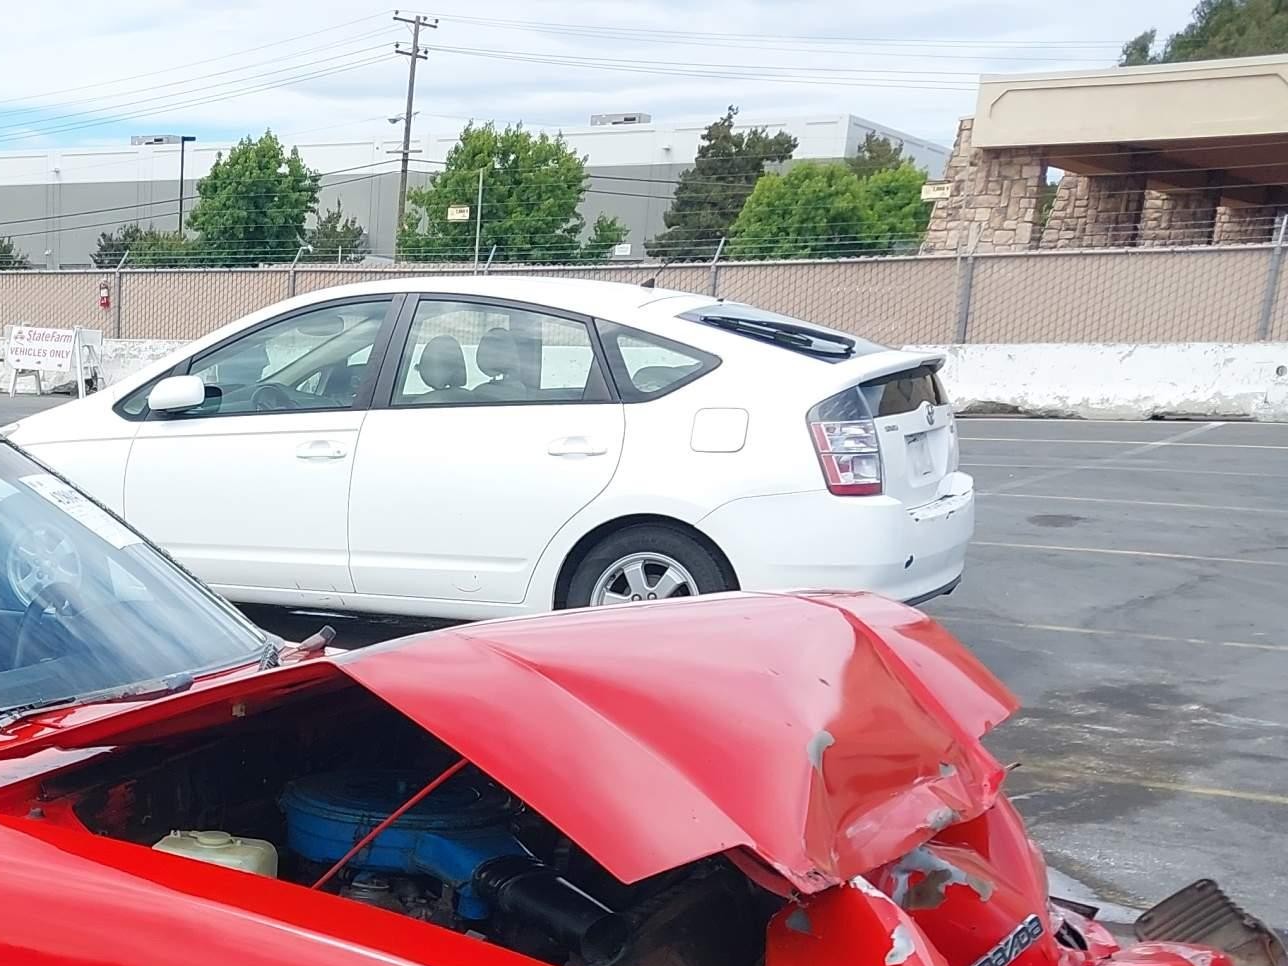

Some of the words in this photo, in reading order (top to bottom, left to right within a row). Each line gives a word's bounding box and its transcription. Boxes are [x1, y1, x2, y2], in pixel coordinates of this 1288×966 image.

[26, 330, 72, 343] StateFarm
[10, 347, 47, 357] VEHICLES
[49, 349, 70, 358] ONLY
